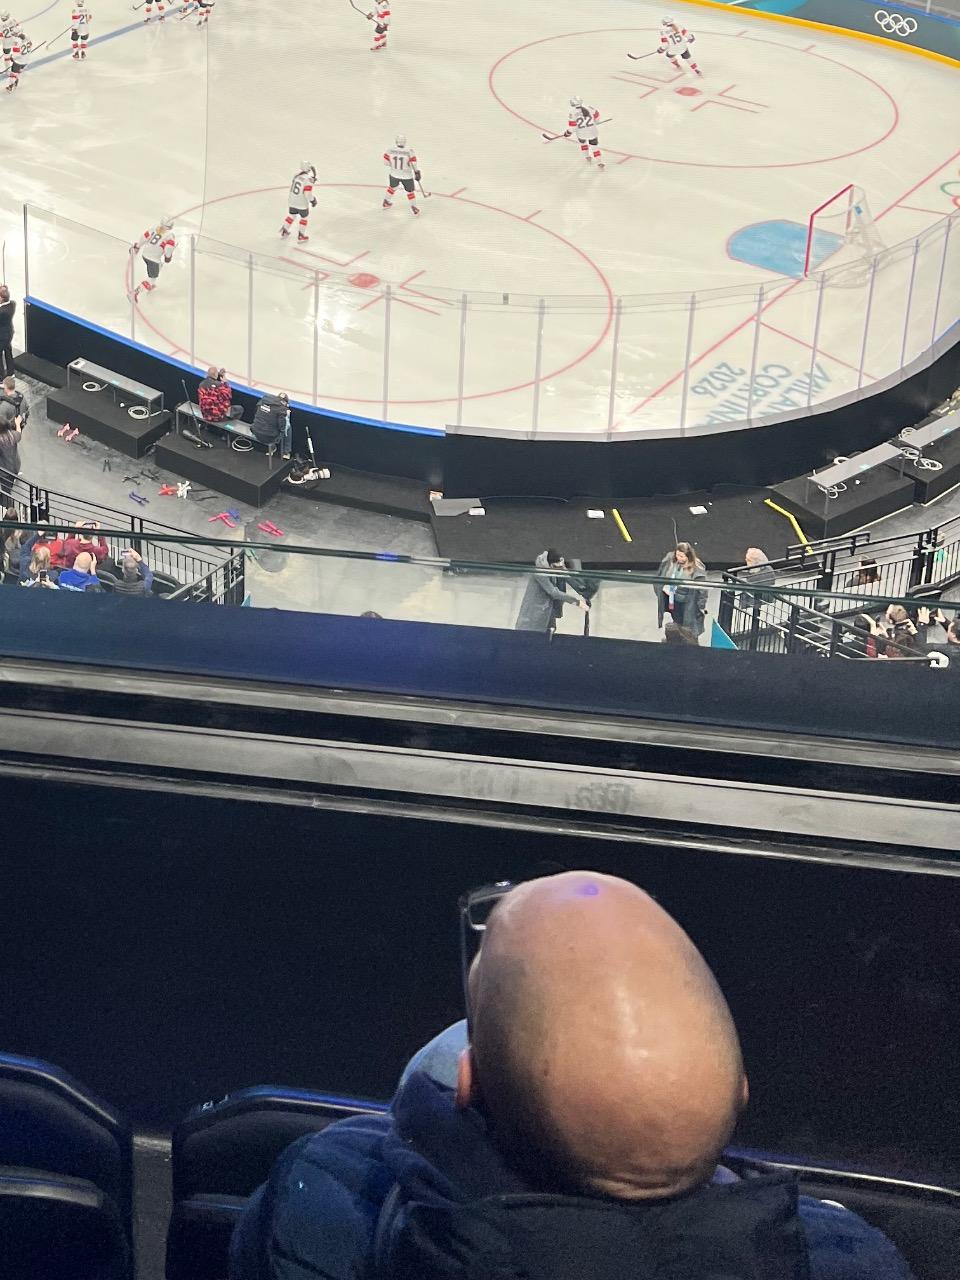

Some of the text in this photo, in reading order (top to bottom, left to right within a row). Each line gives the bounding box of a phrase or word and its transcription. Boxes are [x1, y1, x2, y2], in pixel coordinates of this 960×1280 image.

[669, 31, 683, 45] 15
[576, 115, 594, 129] 22
[392, 155, 404, 170] 11
[691, 362, 746, 399] 2026
